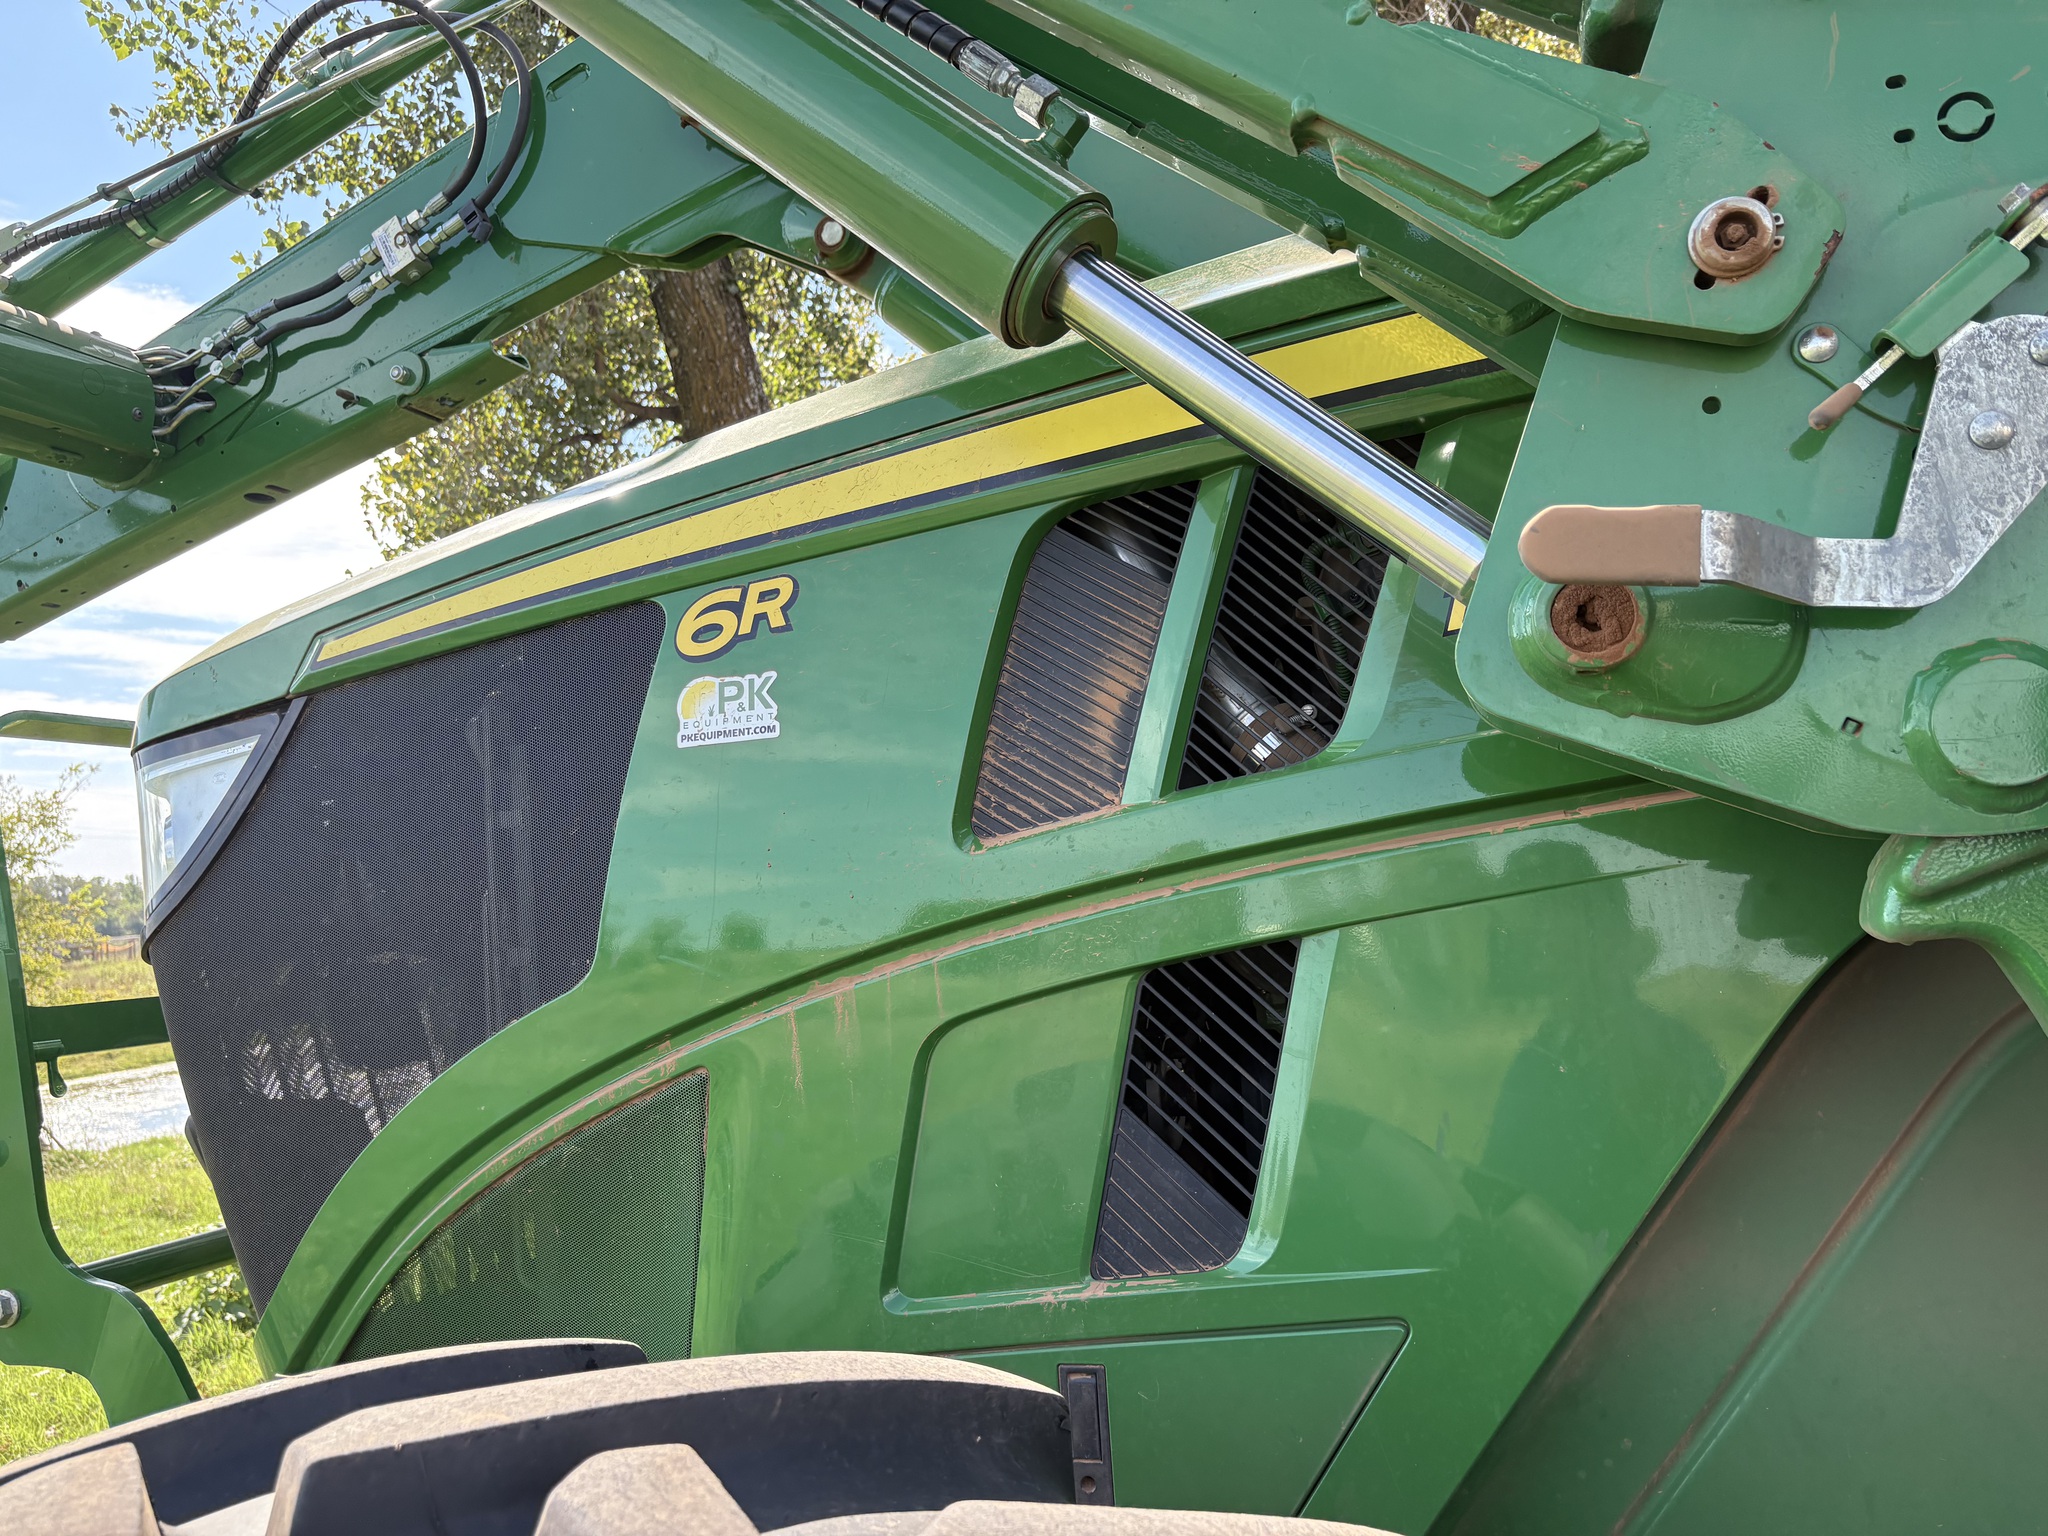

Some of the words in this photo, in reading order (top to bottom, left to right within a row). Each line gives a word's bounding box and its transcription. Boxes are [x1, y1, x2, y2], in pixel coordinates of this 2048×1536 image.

[675, 575, 798, 662] 6R
[719, 676, 774, 714] P&K
[681, 725, 776, 743] PKEQUIPMENT.COM
[683, 712, 774, 730] EQUIPMENT
